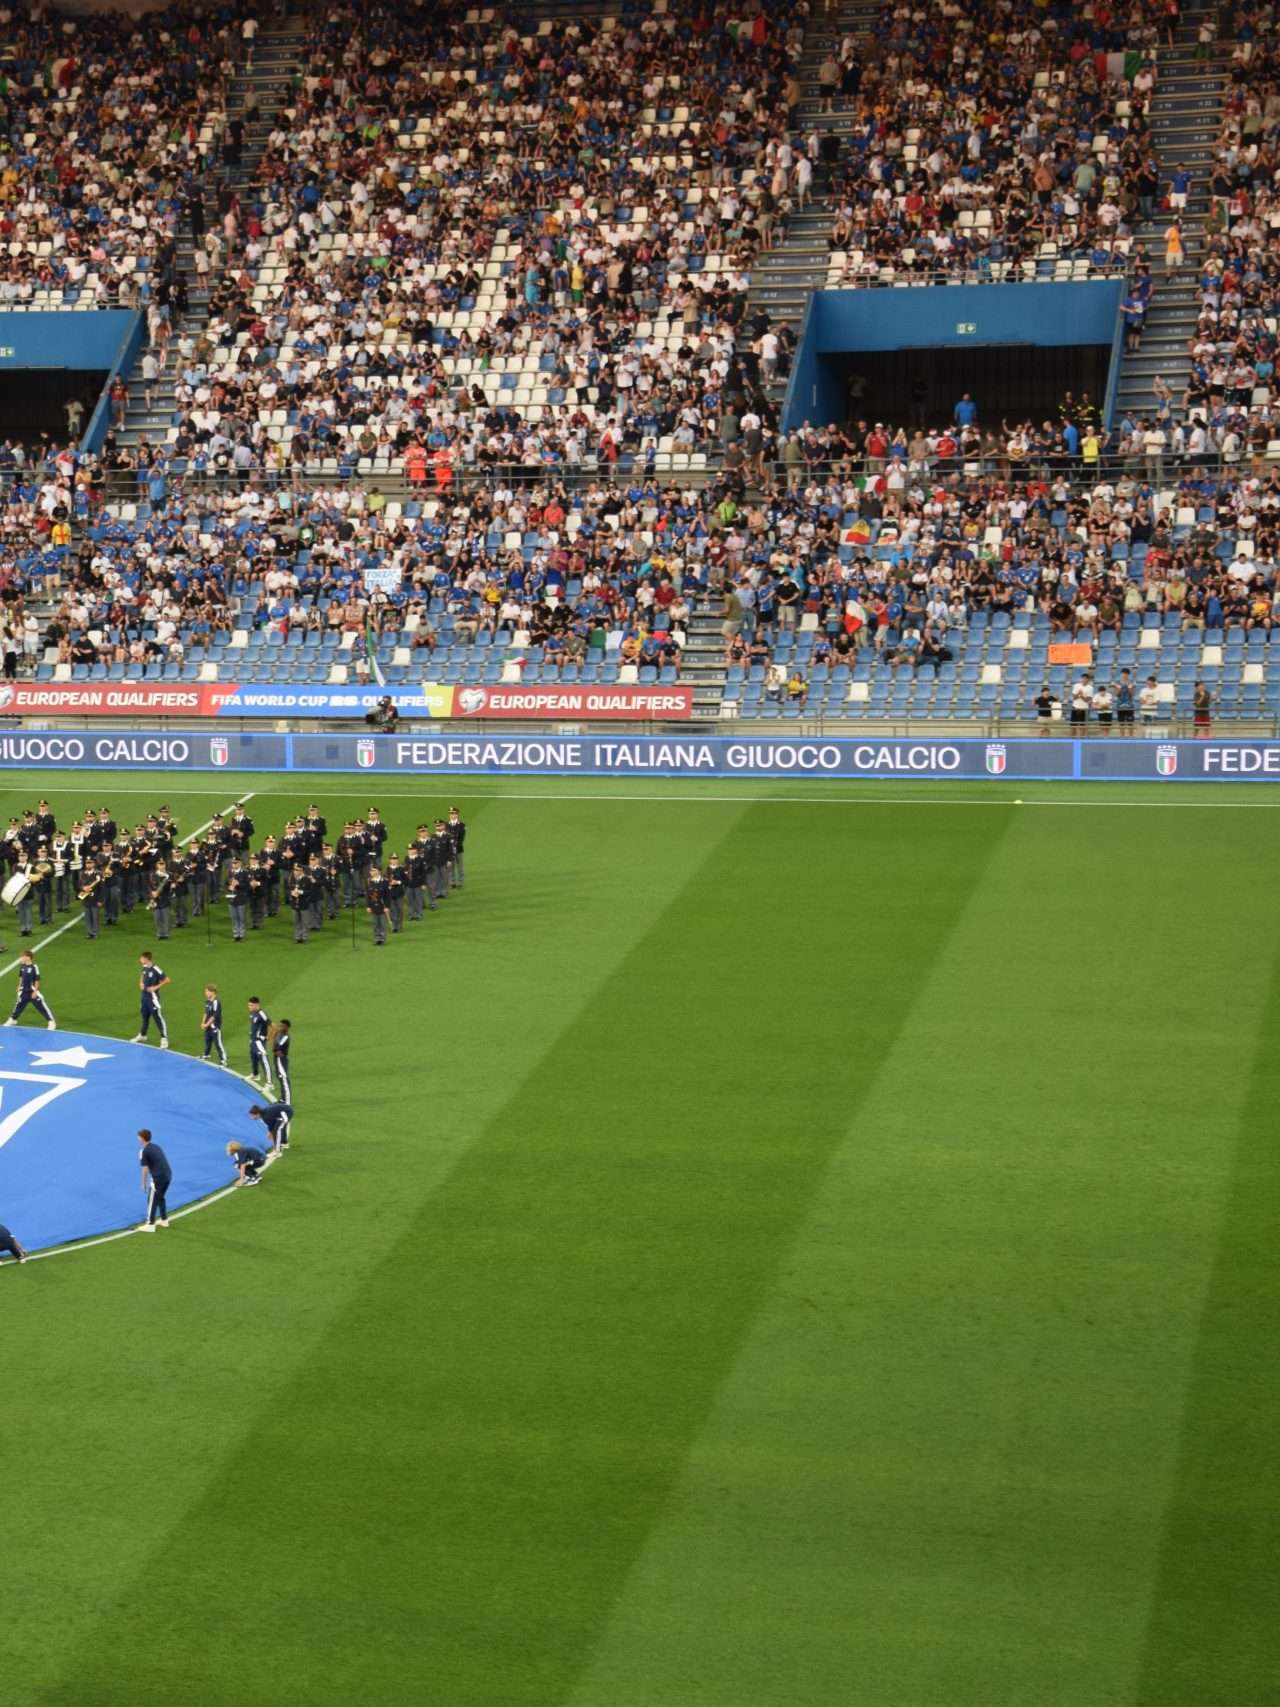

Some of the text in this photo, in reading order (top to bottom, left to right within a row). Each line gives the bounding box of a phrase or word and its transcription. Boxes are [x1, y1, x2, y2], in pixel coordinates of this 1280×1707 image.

[16, 691, 198, 707] EUROPEAN QUALIFIERS
[211, 694, 242, 706] FIFA
[244, 694, 297, 707] WORLD
[299, 695, 329, 707] CUP
[362, 695, 444, 707] QULIFIERS
[489, 695, 686, 711] EUROPEAN QUALIFIERS
[95, 739, 189, 762] CALCIO
[396, 743, 961, 770] FEDERAZIONE ITALIANA GIUOCO CALCIO
[1203, 748, 1280, 772] FEDE
